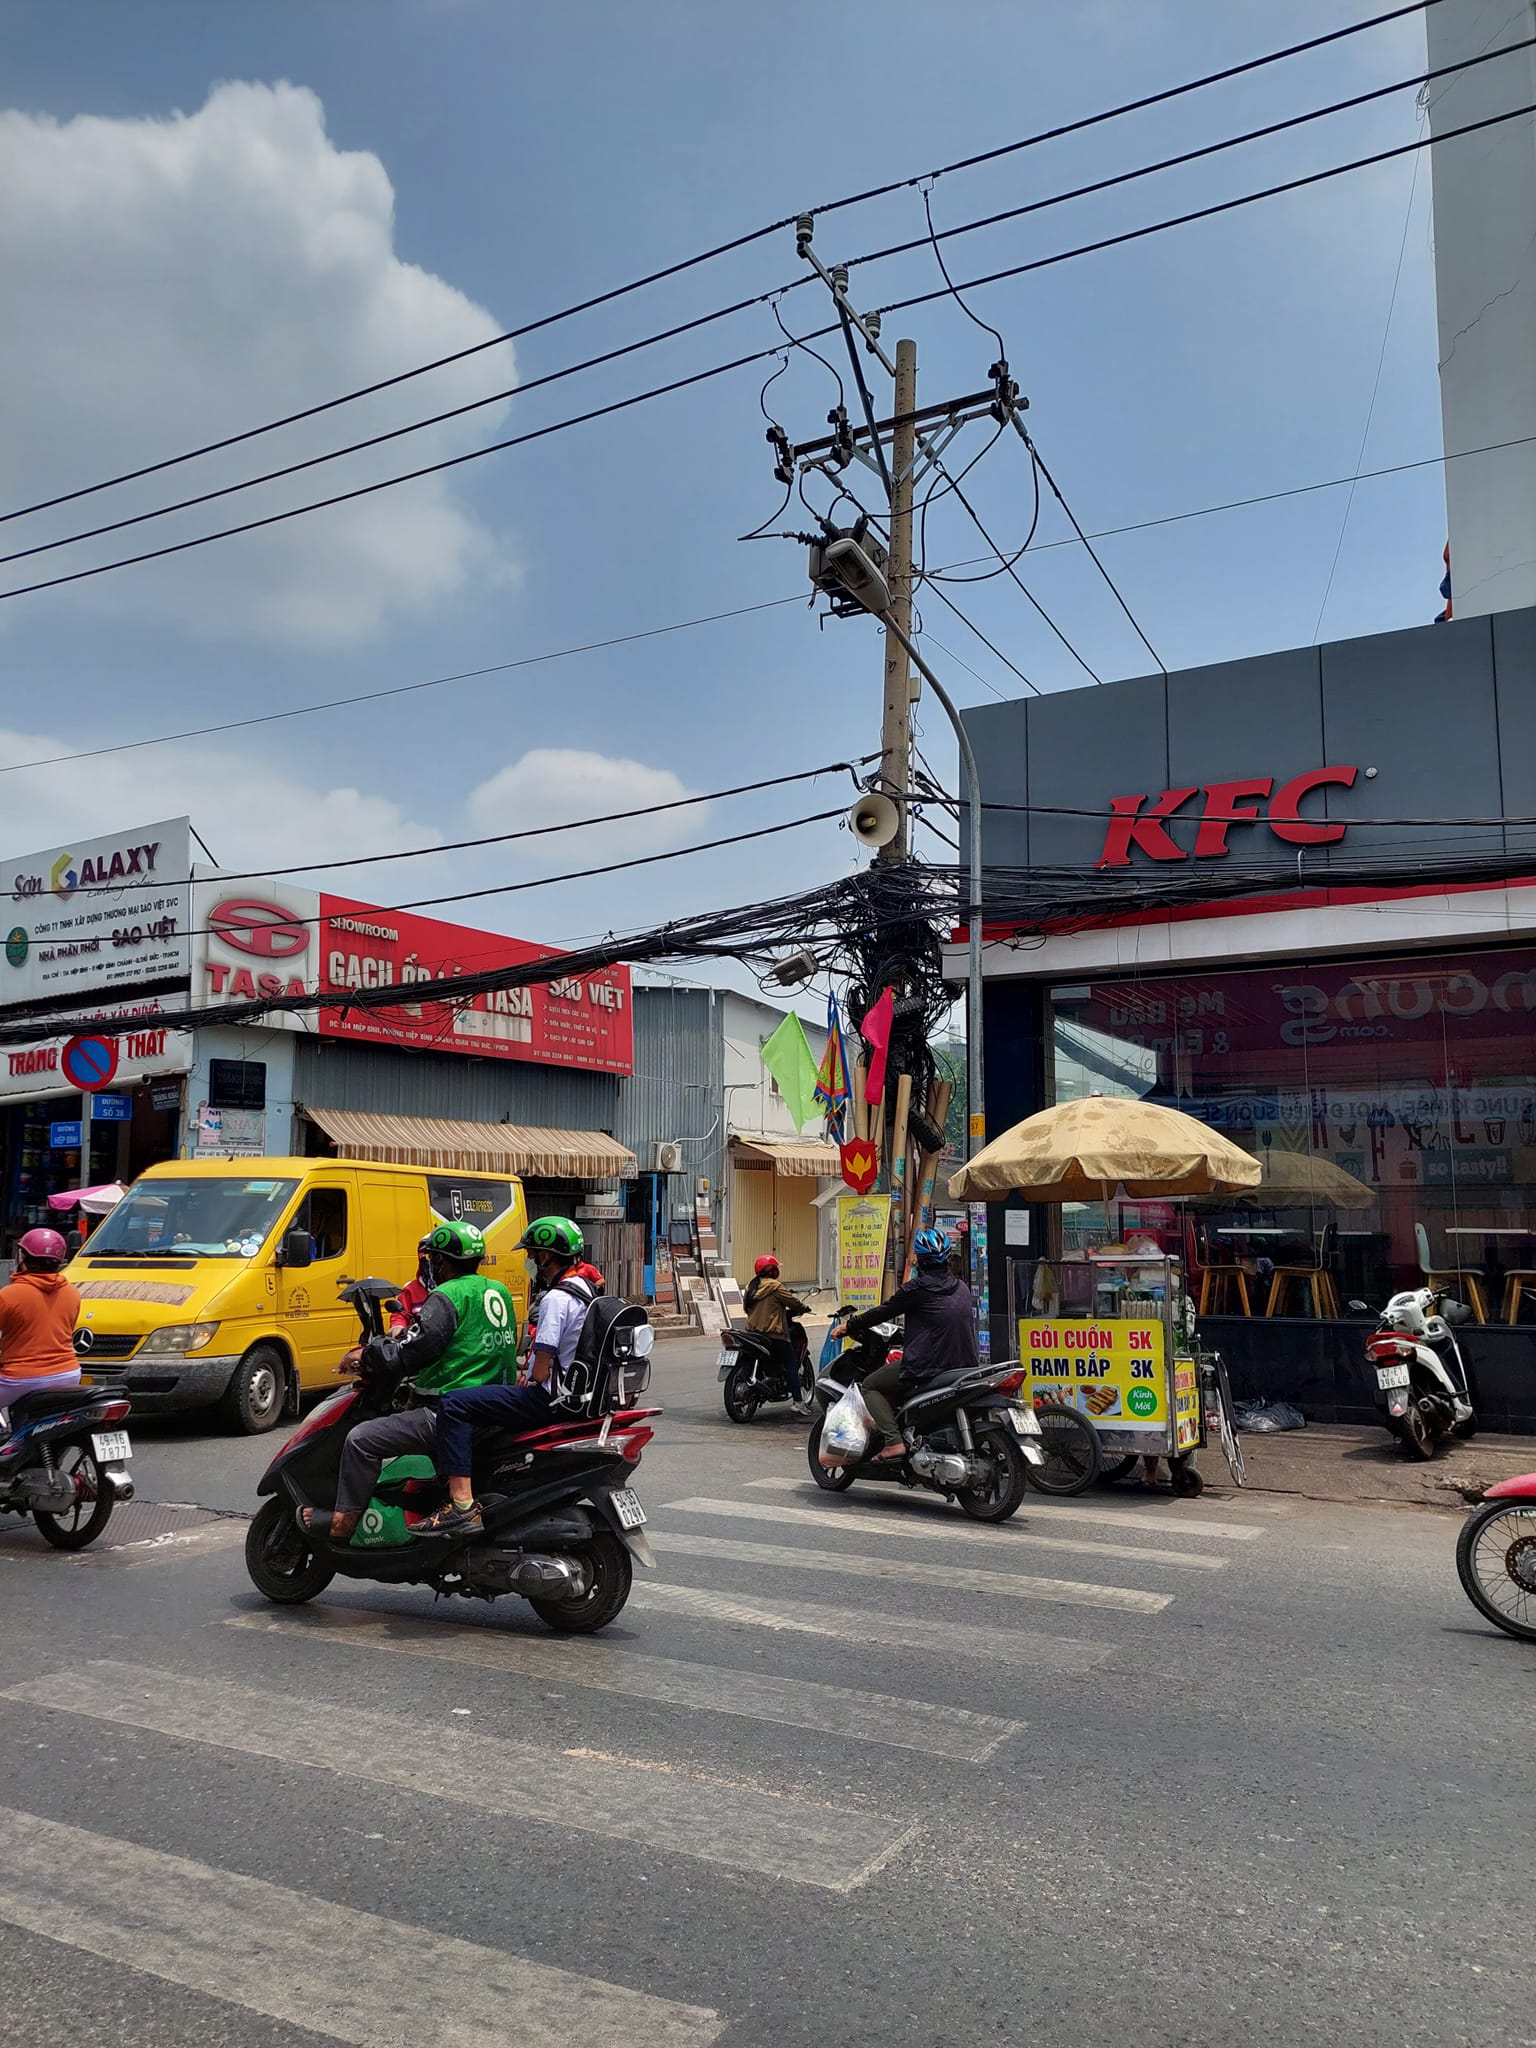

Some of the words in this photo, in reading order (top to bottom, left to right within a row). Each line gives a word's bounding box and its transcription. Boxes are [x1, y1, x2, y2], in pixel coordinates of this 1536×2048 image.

[1094, 766, 1358, 868] KFC
[51, 921, 59, 931] TY
[140, 902, 152, 913] SAO
[153, 898, 165, 912] VIỆT
[166, 897, 179, 908] SVC
[39, 946, 56, 962] NHÀ
[112, 926, 142, 947] SAO
[147, 915, 178, 945] VIỆT
[329, 917, 399, 942] SHOWROOM
[205, 963, 307, 1000] TASA
[486, 986, 534, 1017] TASA
[548, 977, 582, 1001] SAO
[588, 979, 625, 1013] VIỆT
[8, 1047, 58, 1076] TRANG
[102, 1107, 114, 1117] SỐ
[115, 1109, 125, 1117] 38
[1427, 1162, 1448, 1176] so
[482, 1327, 516, 1353] gojek
[1029, 1324, 1058, 1349] GỎI
[1064, 1324, 1113, 1349] CUỐN
[1128, 1331, 1153, 1350] 5K
[1031, 1358, 1069, 1377] RAM
[1075, 1352, 1111, 1378] BẮP
[1130, 1360, 1155, 1378] 3K
[101, 1445, 127, 1460] 7877
[364, 1535, 385, 1545] gojek
